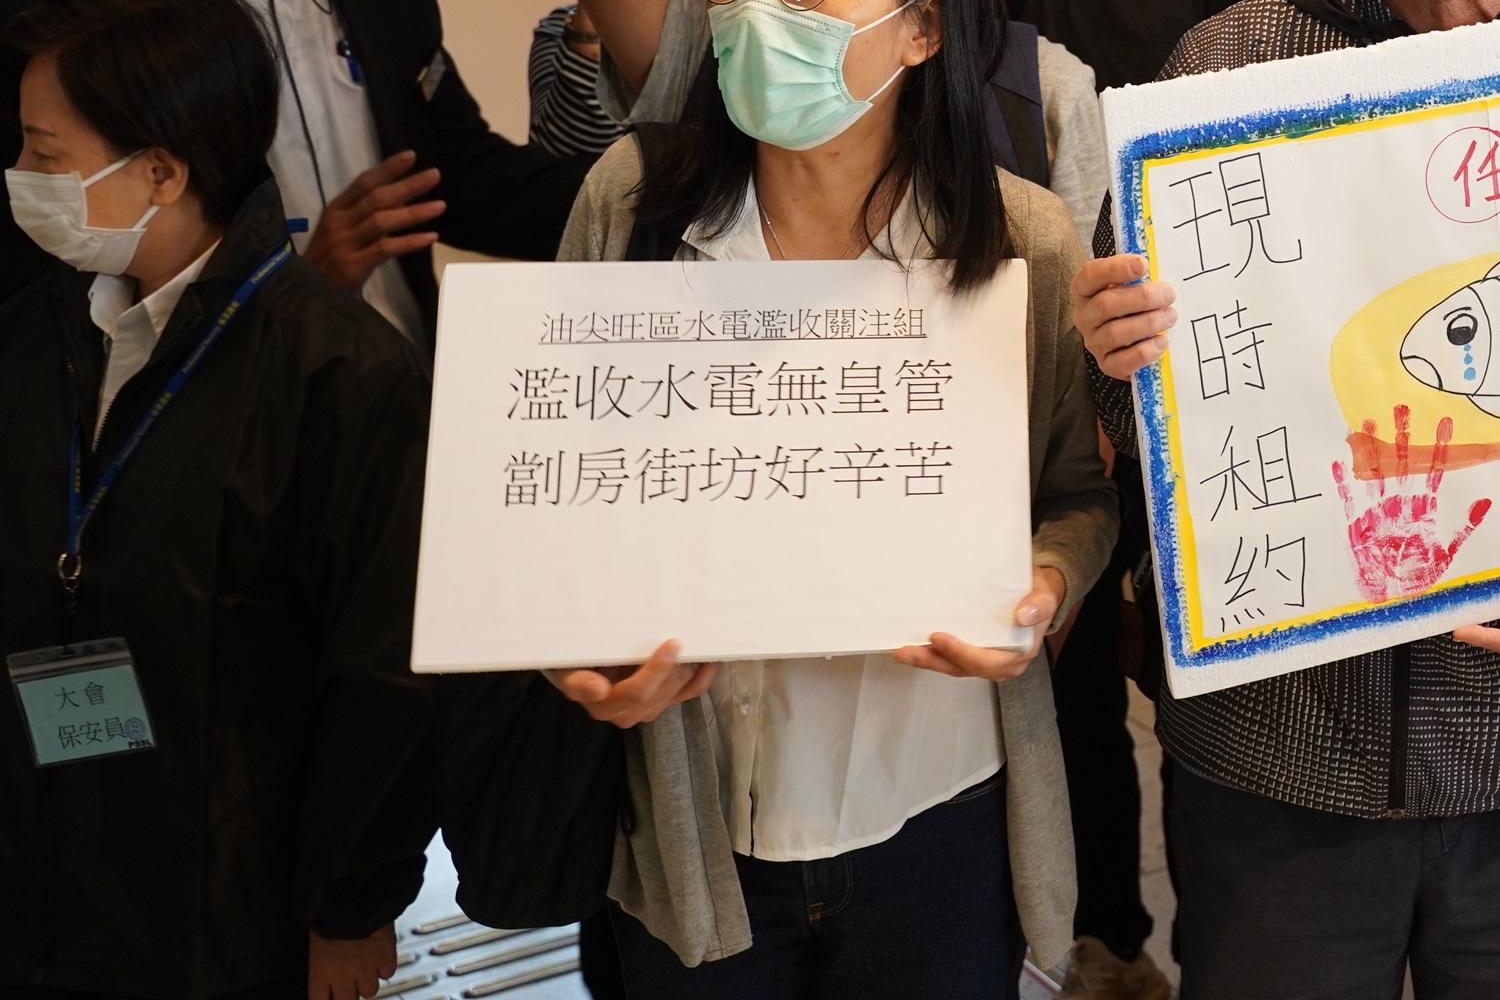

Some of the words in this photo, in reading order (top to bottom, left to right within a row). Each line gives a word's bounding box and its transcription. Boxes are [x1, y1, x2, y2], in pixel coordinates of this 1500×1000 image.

[539, 307, 928, 344] 油尖旺區水電濫收關注組
[506, 359, 954, 422] 濫收水電無皇管
[1167, 151, 1323, 634] 現時租約
[503, 442, 954, 508] 劏房街坊好辛苦
[53, 681, 106, 712] 大會
[57, 716, 127, 750] 保安員
